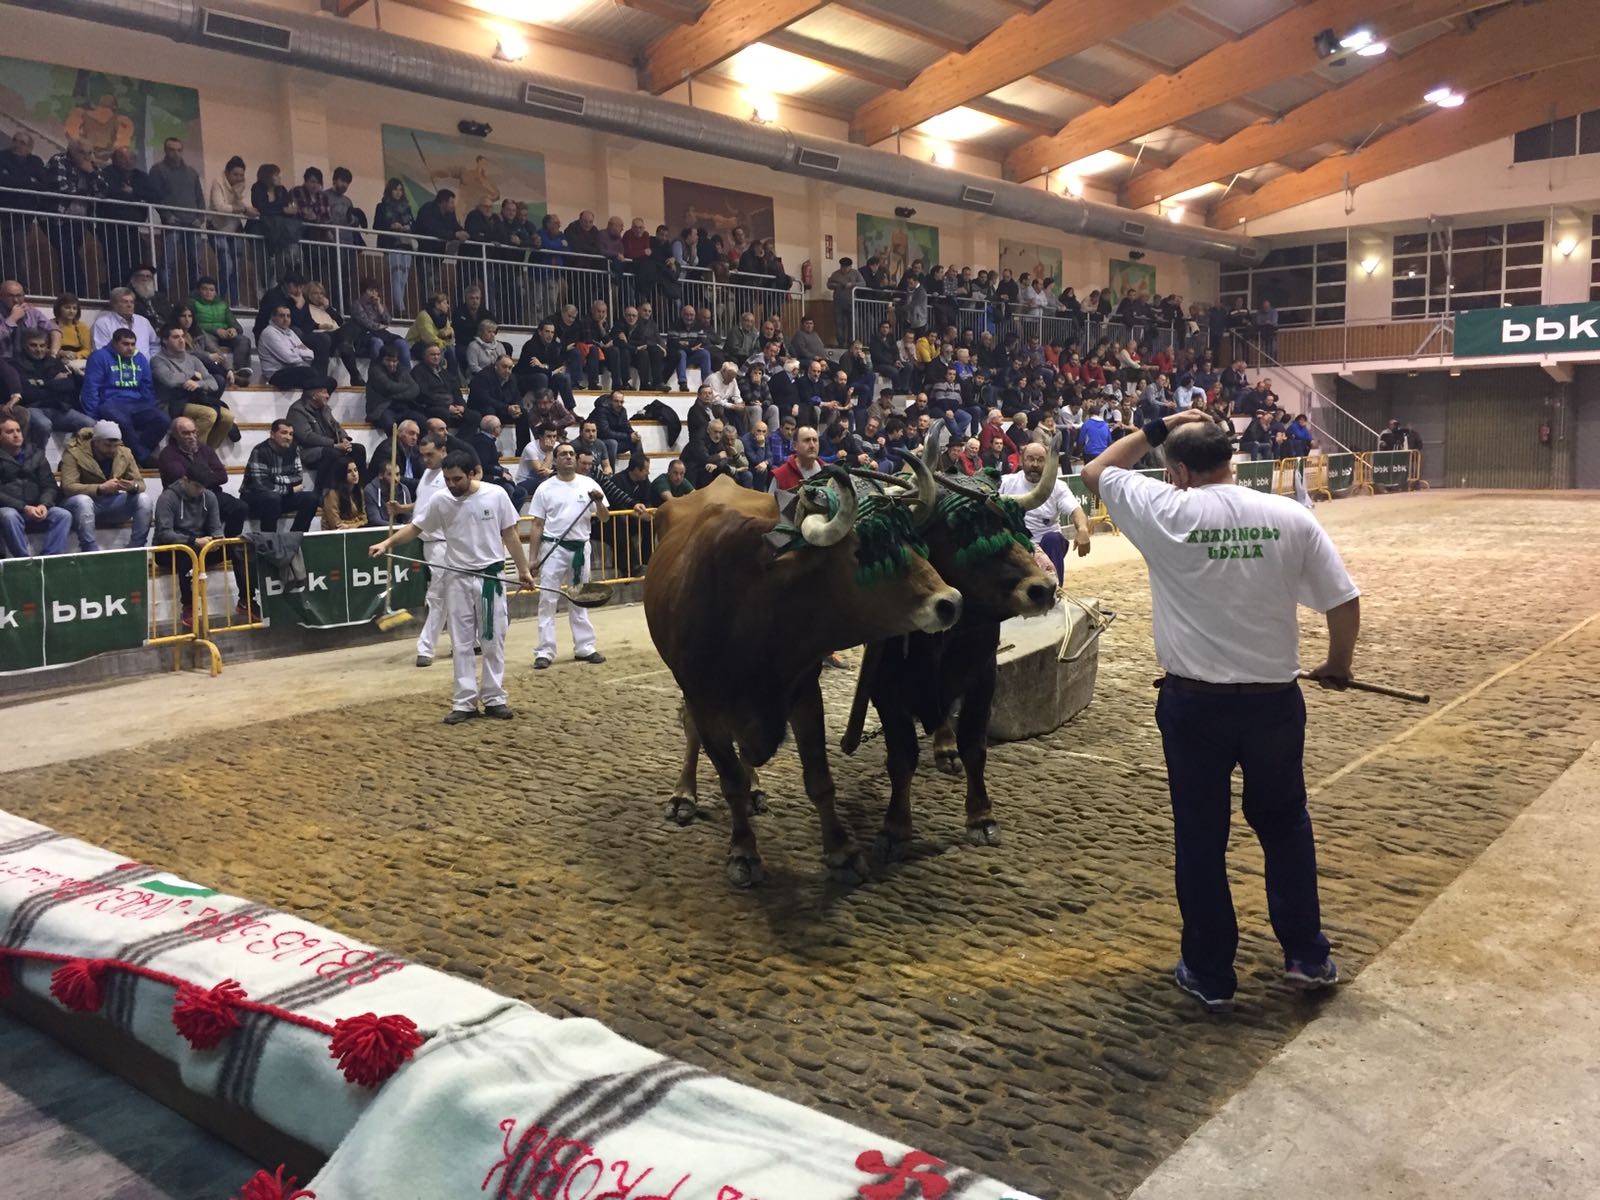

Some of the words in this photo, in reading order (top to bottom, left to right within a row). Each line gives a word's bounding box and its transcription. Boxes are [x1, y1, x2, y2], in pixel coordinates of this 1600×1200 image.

[1501, 315, 1599, 343] bbk
[1392, 464, 1407, 473] bbk
[1207, 544, 1264, 560] UDALA
[265, 572, 328, 596] bk
[352, 564, 410, 587] bbk
[52, 595, 128, 623] bbk
